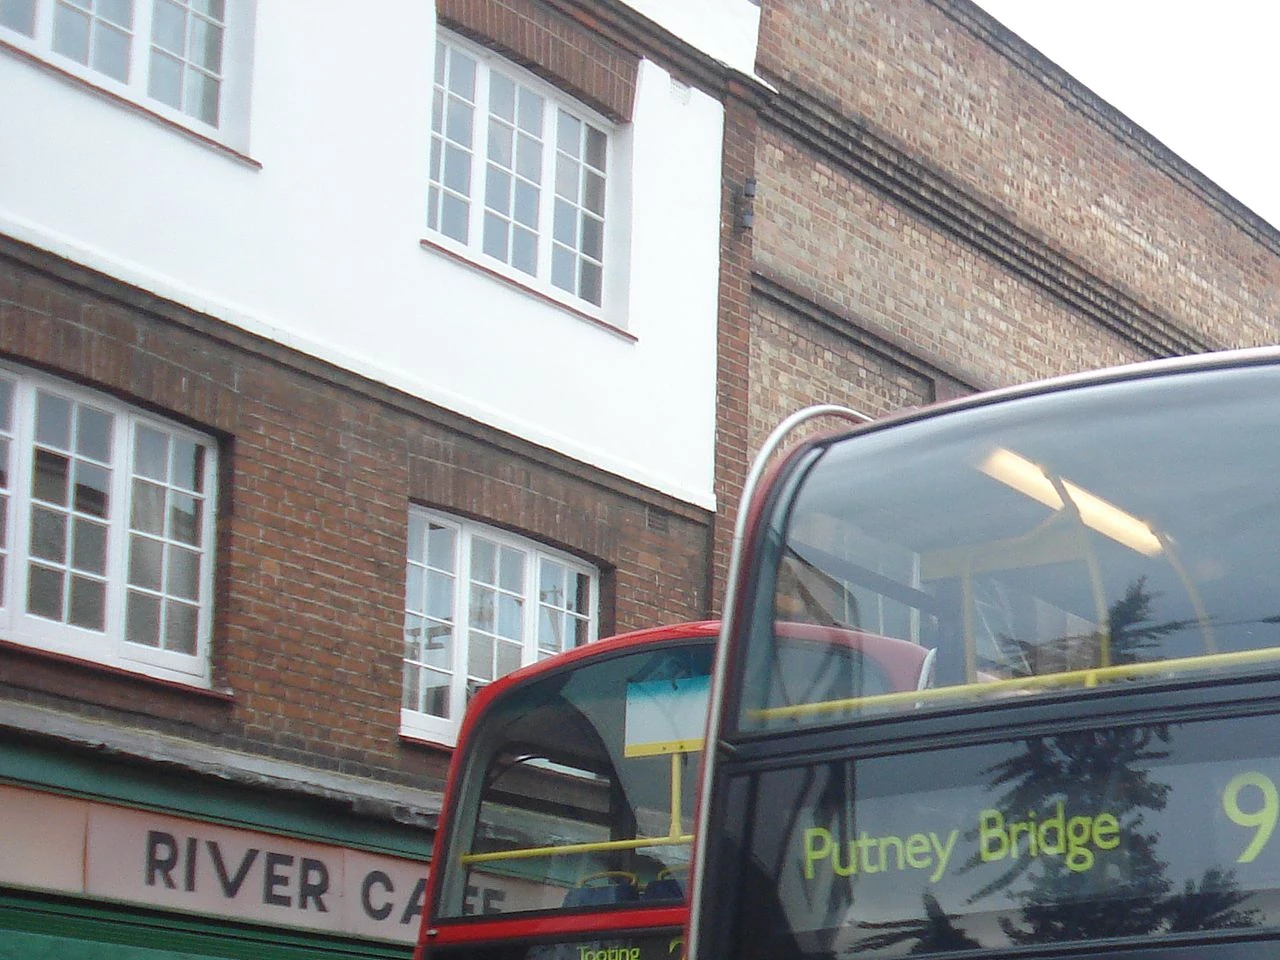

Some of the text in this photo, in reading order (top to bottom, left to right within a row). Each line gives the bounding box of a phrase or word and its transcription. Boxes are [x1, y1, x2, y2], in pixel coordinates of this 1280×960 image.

[145, 830, 329, 913] RIVER
[805, 800, 1121, 883] Putney Bridge
